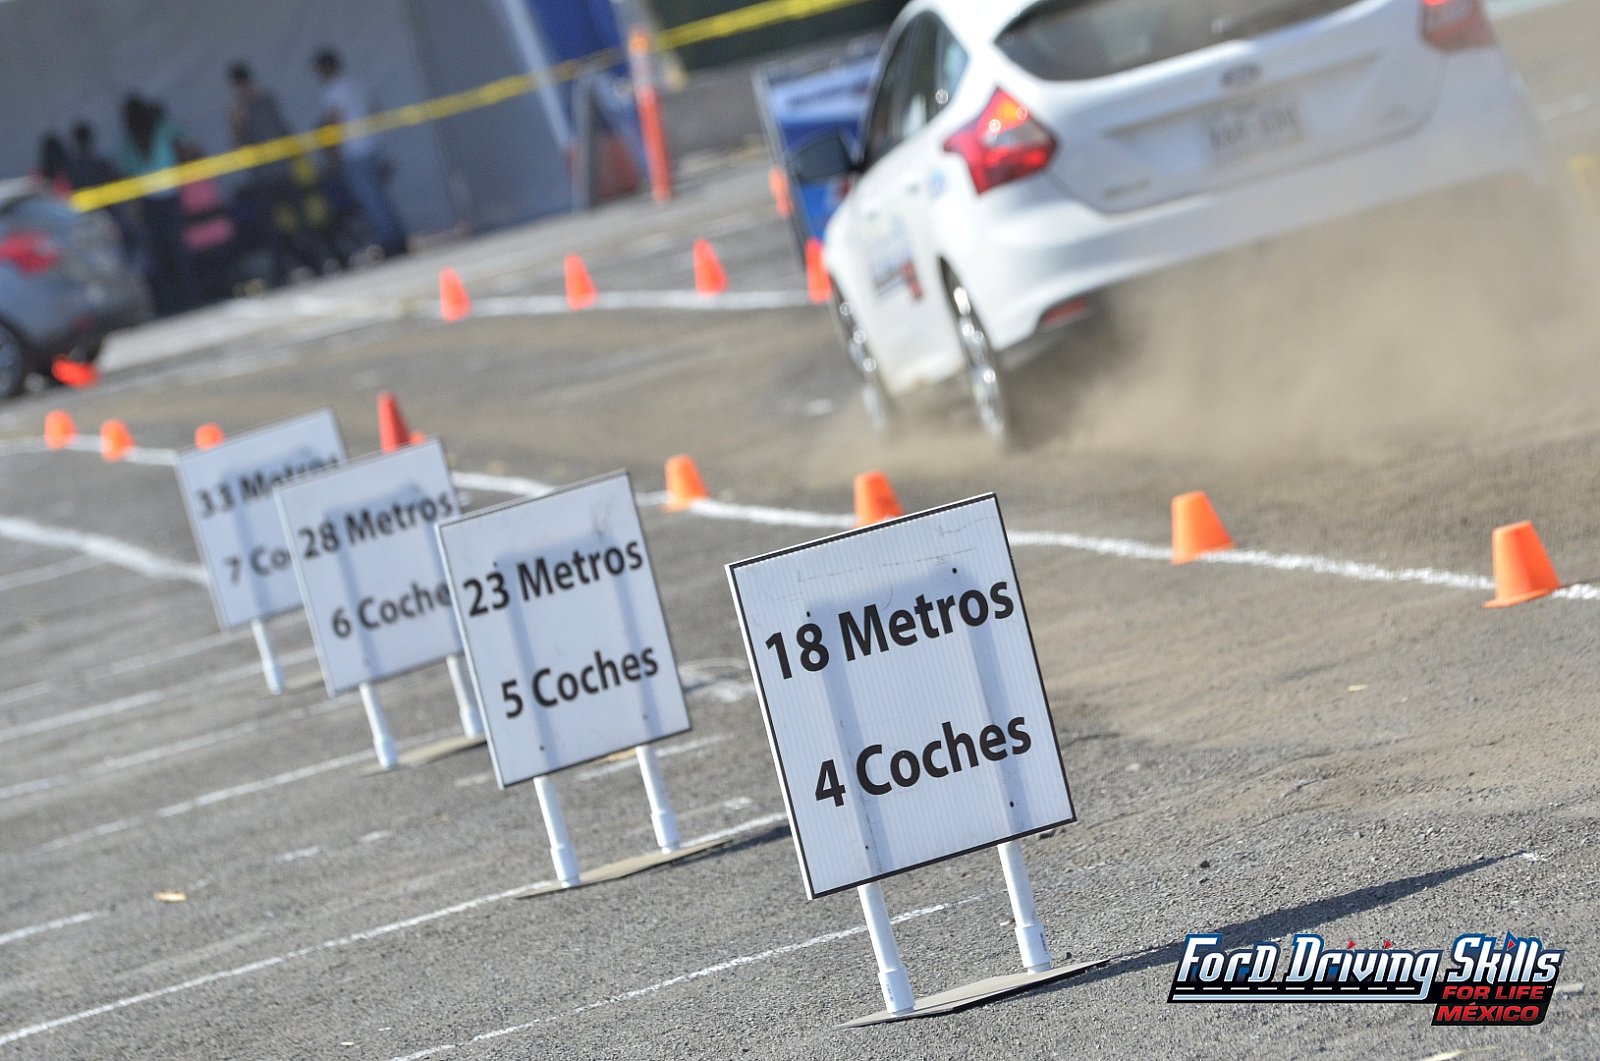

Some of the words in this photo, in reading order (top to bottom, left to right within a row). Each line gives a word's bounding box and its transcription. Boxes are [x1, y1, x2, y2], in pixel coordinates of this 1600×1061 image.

[298, 521, 341, 560] 28
[344, 492, 453, 546] Metros
[223, 554, 242, 586] 7
[462, 570, 510, 617] 23
[516, 541, 643, 602] Metros
[331, 606, 353, 638] 6
[356, 580, 453, 630] Coche
[765, 622, 829, 680] 18
[838, 580, 1015, 662] Metros
[501, 679, 524, 719] 5
[532, 646, 659, 708] Coches
[814, 759, 847, 808] 4
[855, 716, 1032, 796] Coches
